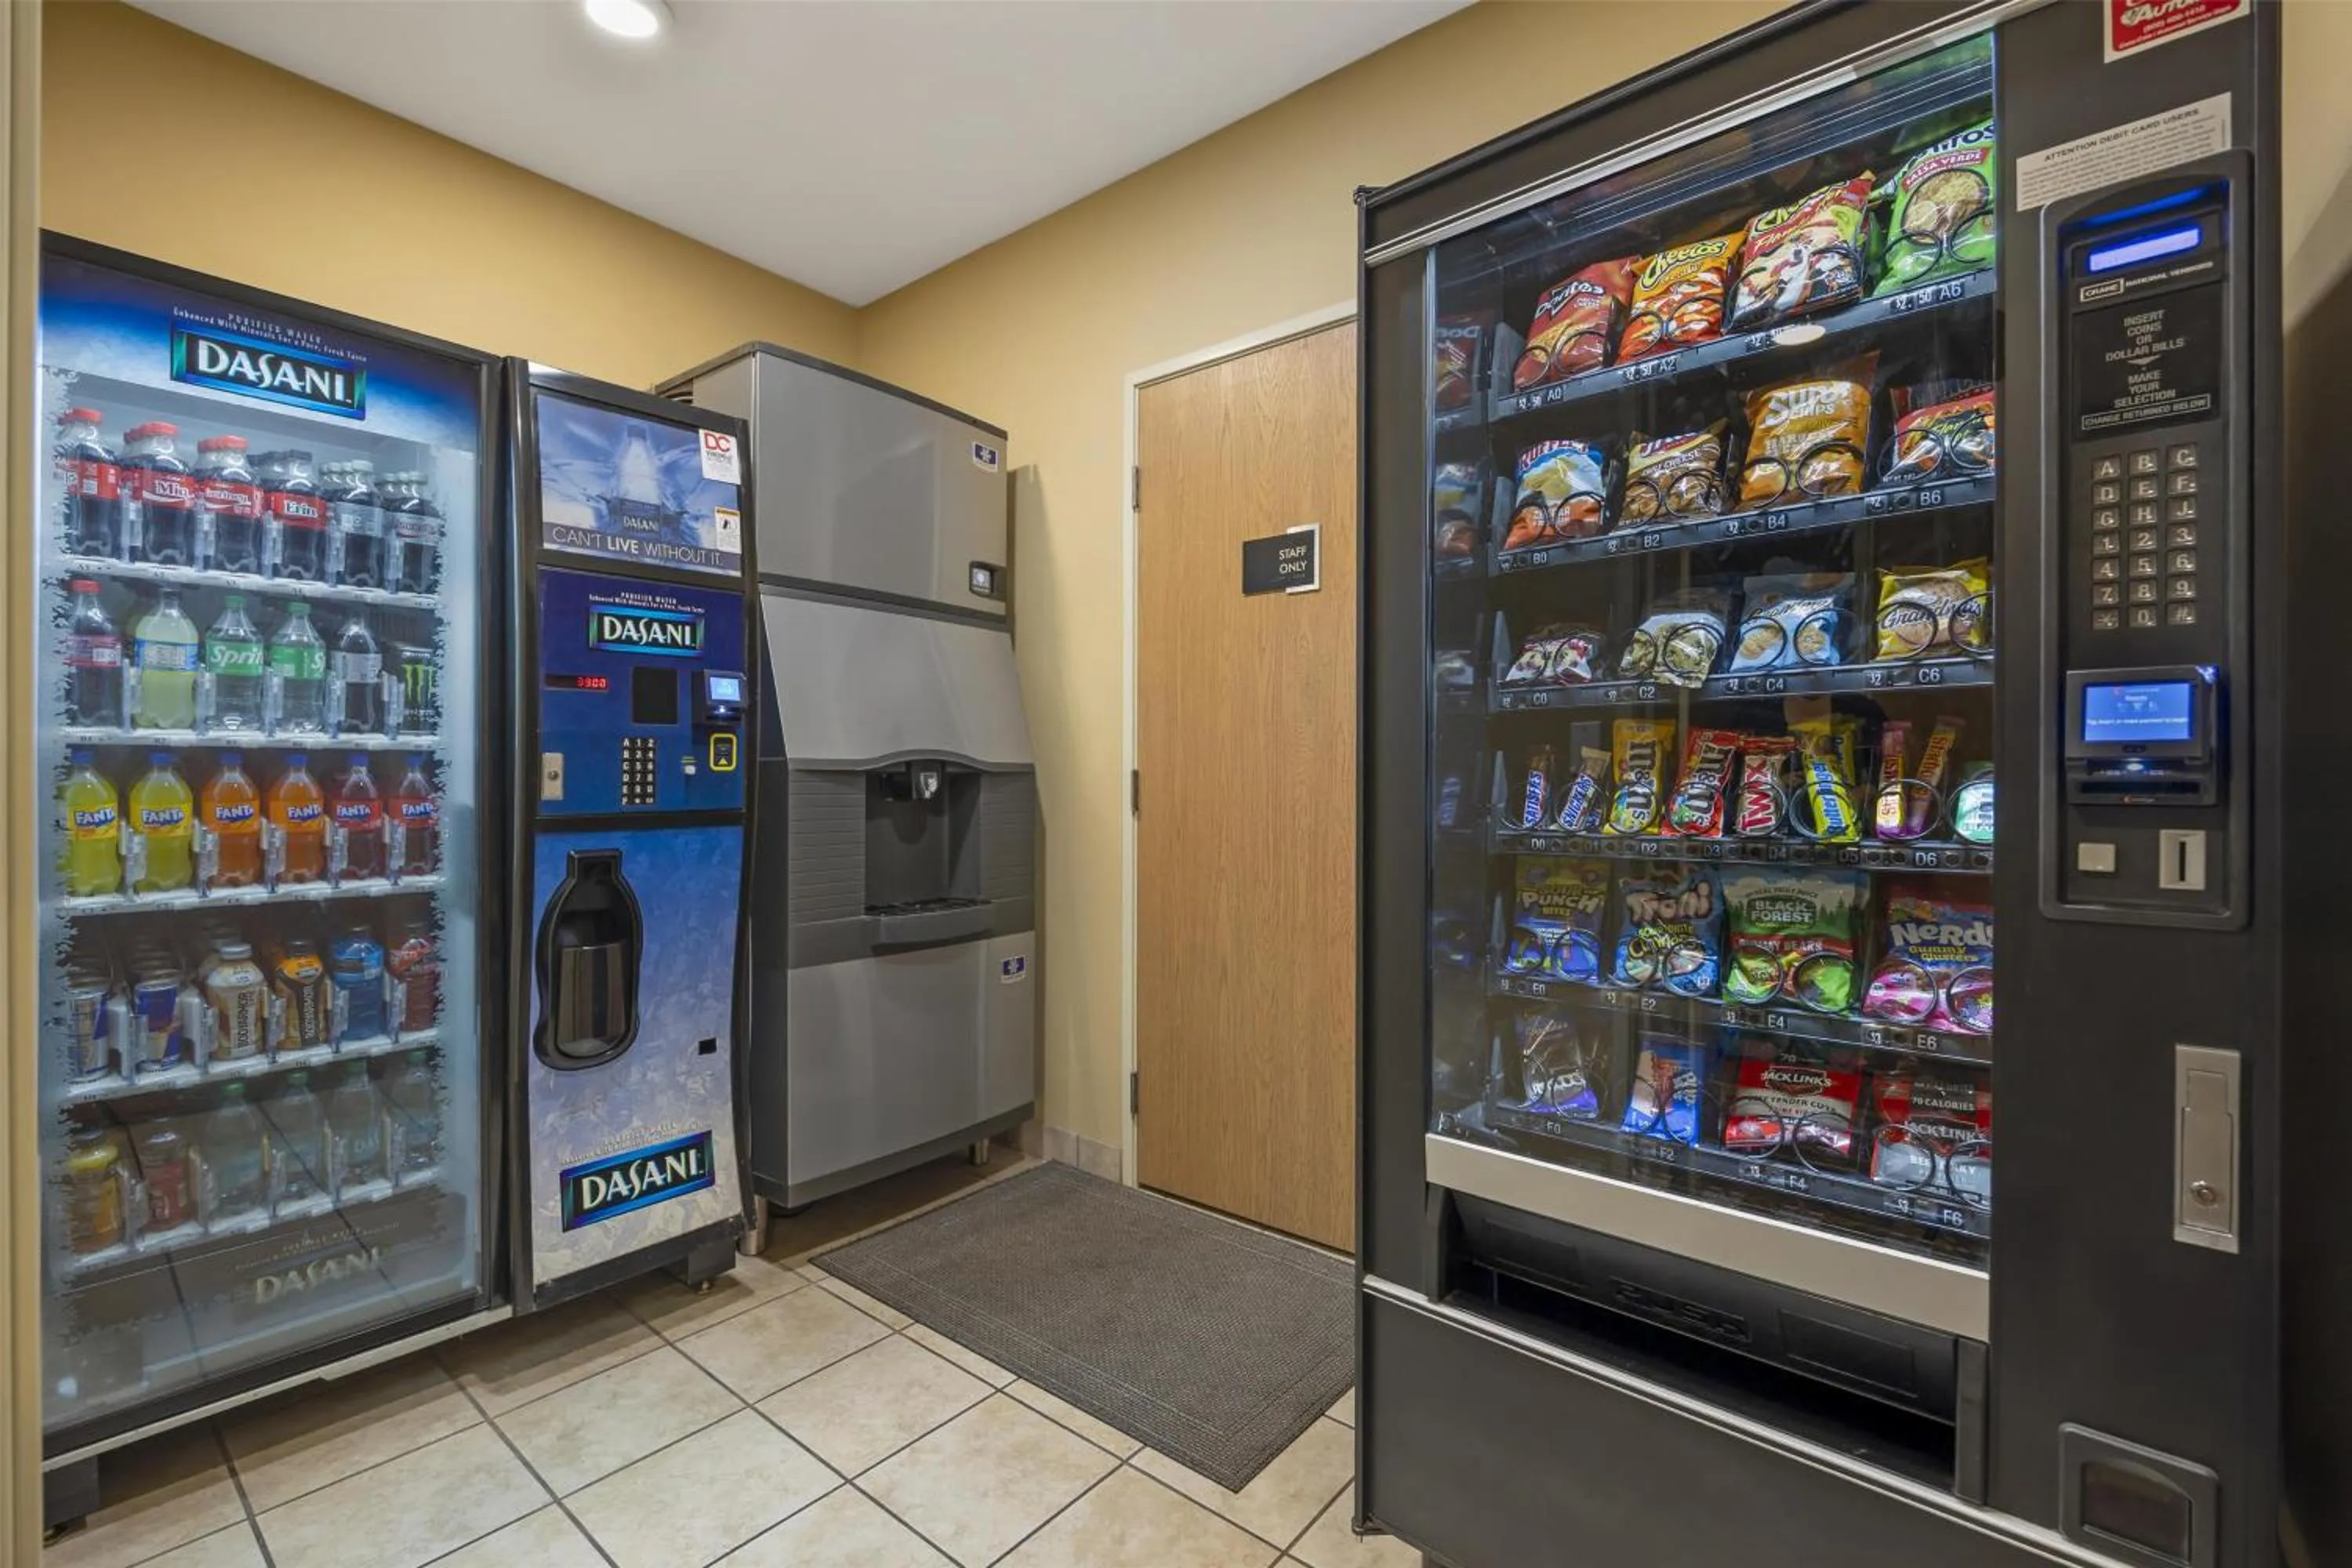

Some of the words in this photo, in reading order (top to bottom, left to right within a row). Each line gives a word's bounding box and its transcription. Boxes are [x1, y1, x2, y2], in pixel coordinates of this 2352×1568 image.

[2045, 140, 2097, 162] ATTENTION
[2099, 129, 2128, 145] DEBIT
[2132, 120, 2161, 134] CARD
[2164, 107, 2200, 125] USERS
[1642, 240, 1729, 289] Cheetos
[1938, 285, 1963, 300] A6
[2085, 284, 2118, 297] CRANE
[1534, 281, 1606, 320] Doritos
[2124, 310, 2165, 327] INSERT
[2127, 321, 2161, 337] COINS
[2136, 335, 2153, 346] OR
[2106, 346, 2149, 362] DOLLAR
[2152, 338, 2185, 352] BILLS
[198, 339, 345, 402] DASANI
[1659, 358, 1677, 372] A2
[2128, 370, 2161, 384] MAKE
[2129, 381, 2161, 394] YOUR
[2114, 389, 2176, 408] SELECTION
[2085, 412, 2120, 426] CHANGE
[2122, 405, 2171, 420] RETURNED
[2172, 398, 2207, 412] BELOW
[703, 432, 731, 452] DC
[2101, 461, 2114, 475] A
[2138, 455, 2151, 470] B
[2176, 449, 2193, 466] C
[2100, 487, 2114, 500] D
[2139, 481, 2151, 495] E
[2176, 476, 2188, 490] F
[1920, 489, 1942, 506] B6
[1767, 514, 1786, 529] B4
[2100, 512, 2114, 526] G
[2138, 506, 2151, 521] H
[2176, 501, 2188, 516] J
[552, 526, 602, 548] CAN'T
[607, 535, 640, 554] LIVE
[644, 541, 706, 564] WITHOUT
[1644, 534, 1660, 548] B2
[2103, 537, 2111, 550] 1
[2139, 532, 2151, 547] 2
[2176, 528, 2190, 542] 3
[1279, 546, 1307, 560] STAFF
[1279, 561, 1308, 575] ONLY
[2100, 562, 2111, 575] 4
[2138, 557, 2151, 572] 5
[2176, 554, 2191, 568] 6
[2101, 587, 2112, 602] 7
[2137, 583, 2151, 599] 8
[2176, 580, 2190, 595] 9
[2137, 609, 2149, 623] 0
[603, 615, 691, 647] DASANI
[210, 644, 263, 666] Sprit
[1918, 667, 1941, 684] C6
[1639, 686, 1655, 699] C2
[1766, 678, 1784, 691] C4
[1533, 692, 1548, 705] C0
[1560, 773, 1593, 829] SNICKERS
[1741, 759, 1774, 831] TWIX
[1915, 852, 1938, 867] D6
[1522, 891, 1599, 914] PUNCH
[1755, 899, 1808, 910] BLACK
[1751, 910, 1813, 923] FOREST
[1909, 945, 1967, 955] Gummy
[1641, 998, 1657, 1011] E2
[1768, 1014, 1784, 1029] E4
[1917, 1034, 1937, 1051] E6
[1760, 1071, 1792, 1083] JACK
[1925, 1099, 1976, 1111] CALORIES
[582, 1149, 699, 1210] DASANI
[1943, 1210, 1964, 1226] F6
[256, 1247, 379, 1304] DASANI
